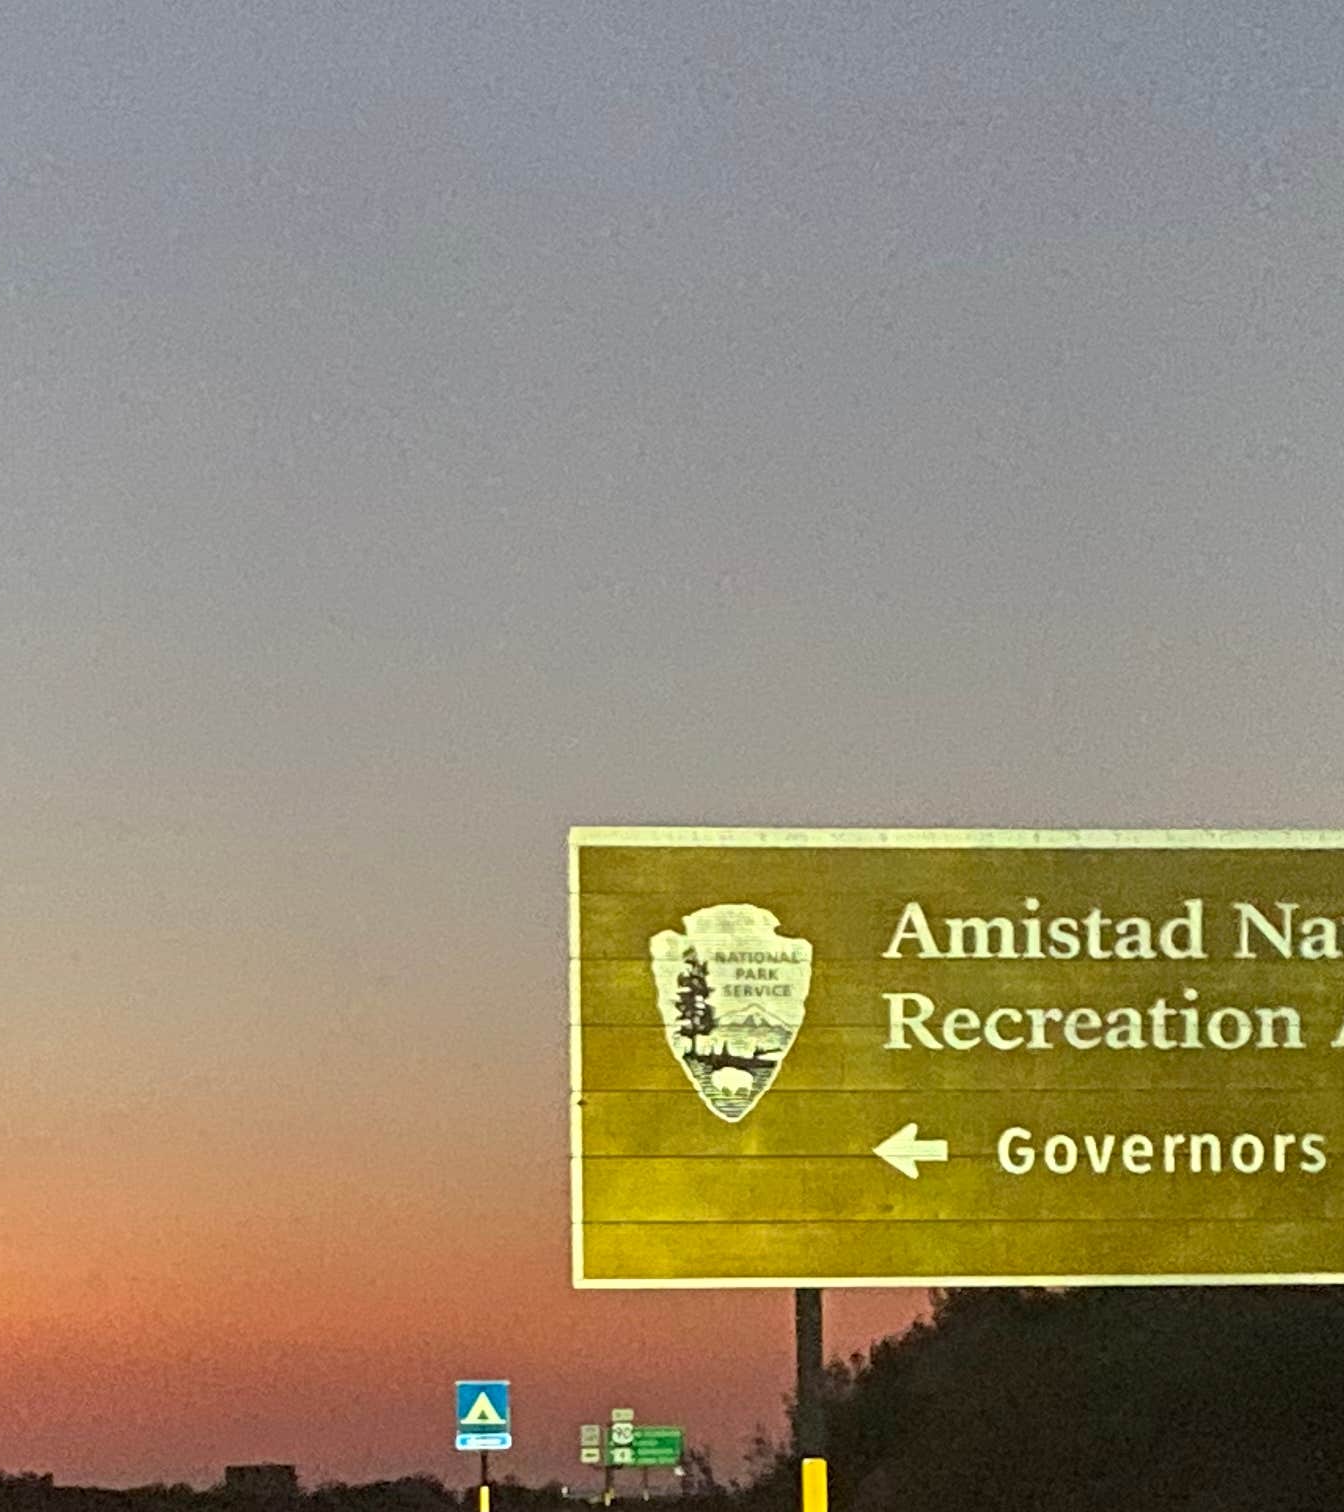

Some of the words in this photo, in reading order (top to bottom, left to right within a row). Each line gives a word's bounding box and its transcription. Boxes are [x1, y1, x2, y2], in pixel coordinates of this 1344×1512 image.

[882, 898, 1207, 959] Amistad
[714, 951, 801, 964] NATIONAL
[735, 967, 779, 981] PARK
[722, 984, 792, 998] SERVICE
[882, 988, 1305, 1050] Recreation
[997, 1126, 1327, 1175] Governors
